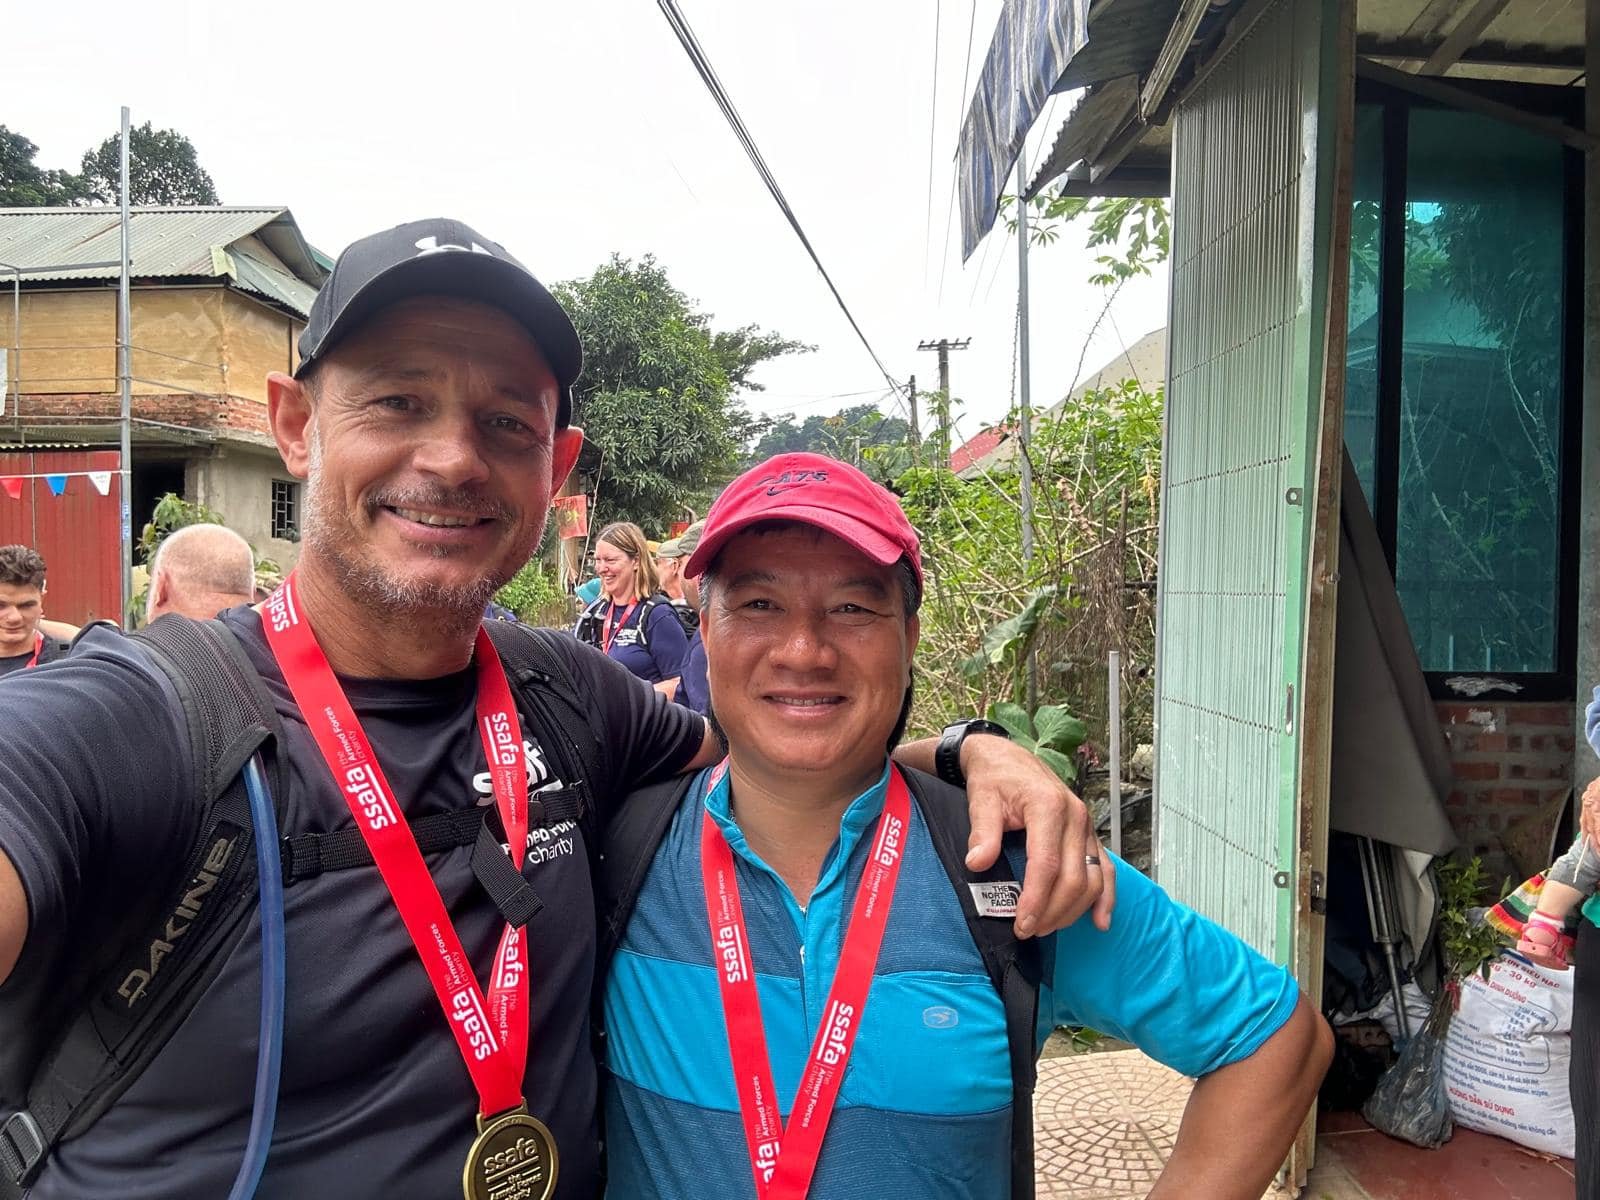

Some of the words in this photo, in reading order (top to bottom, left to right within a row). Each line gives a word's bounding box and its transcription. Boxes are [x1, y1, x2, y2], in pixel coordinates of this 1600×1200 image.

[266, 587, 290, 632] ssafa
[324, 706, 342, 734] Forces
[338, 732, 357, 761] Armed
[492, 712, 520, 765] ssafa
[346, 766, 389, 830] ssafa
[528, 838, 574, 865] charity
[880, 816, 902, 867] ssafa
[991, 899, 1011, 907] FACE
[117, 836, 238, 1008] DAKINE
[430, 923, 447, 955] Forces
[717, 926, 741, 983] ssafa
[443, 954, 461, 985] Armed
[503, 927, 523, 988] safa
[1509, 970, 1522, 981] 30
[452, 990, 491, 1061] ssafa
[824, 1003, 854, 1065] ssafa
[753, 1075, 763, 1106] Forces
[812, 1068, 826, 1098] Armed
[758, 1106, 770, 1137] Armed
[802, 1098, 818, 1128] Forces
[484, 1137, 538, 1175] ssafa
